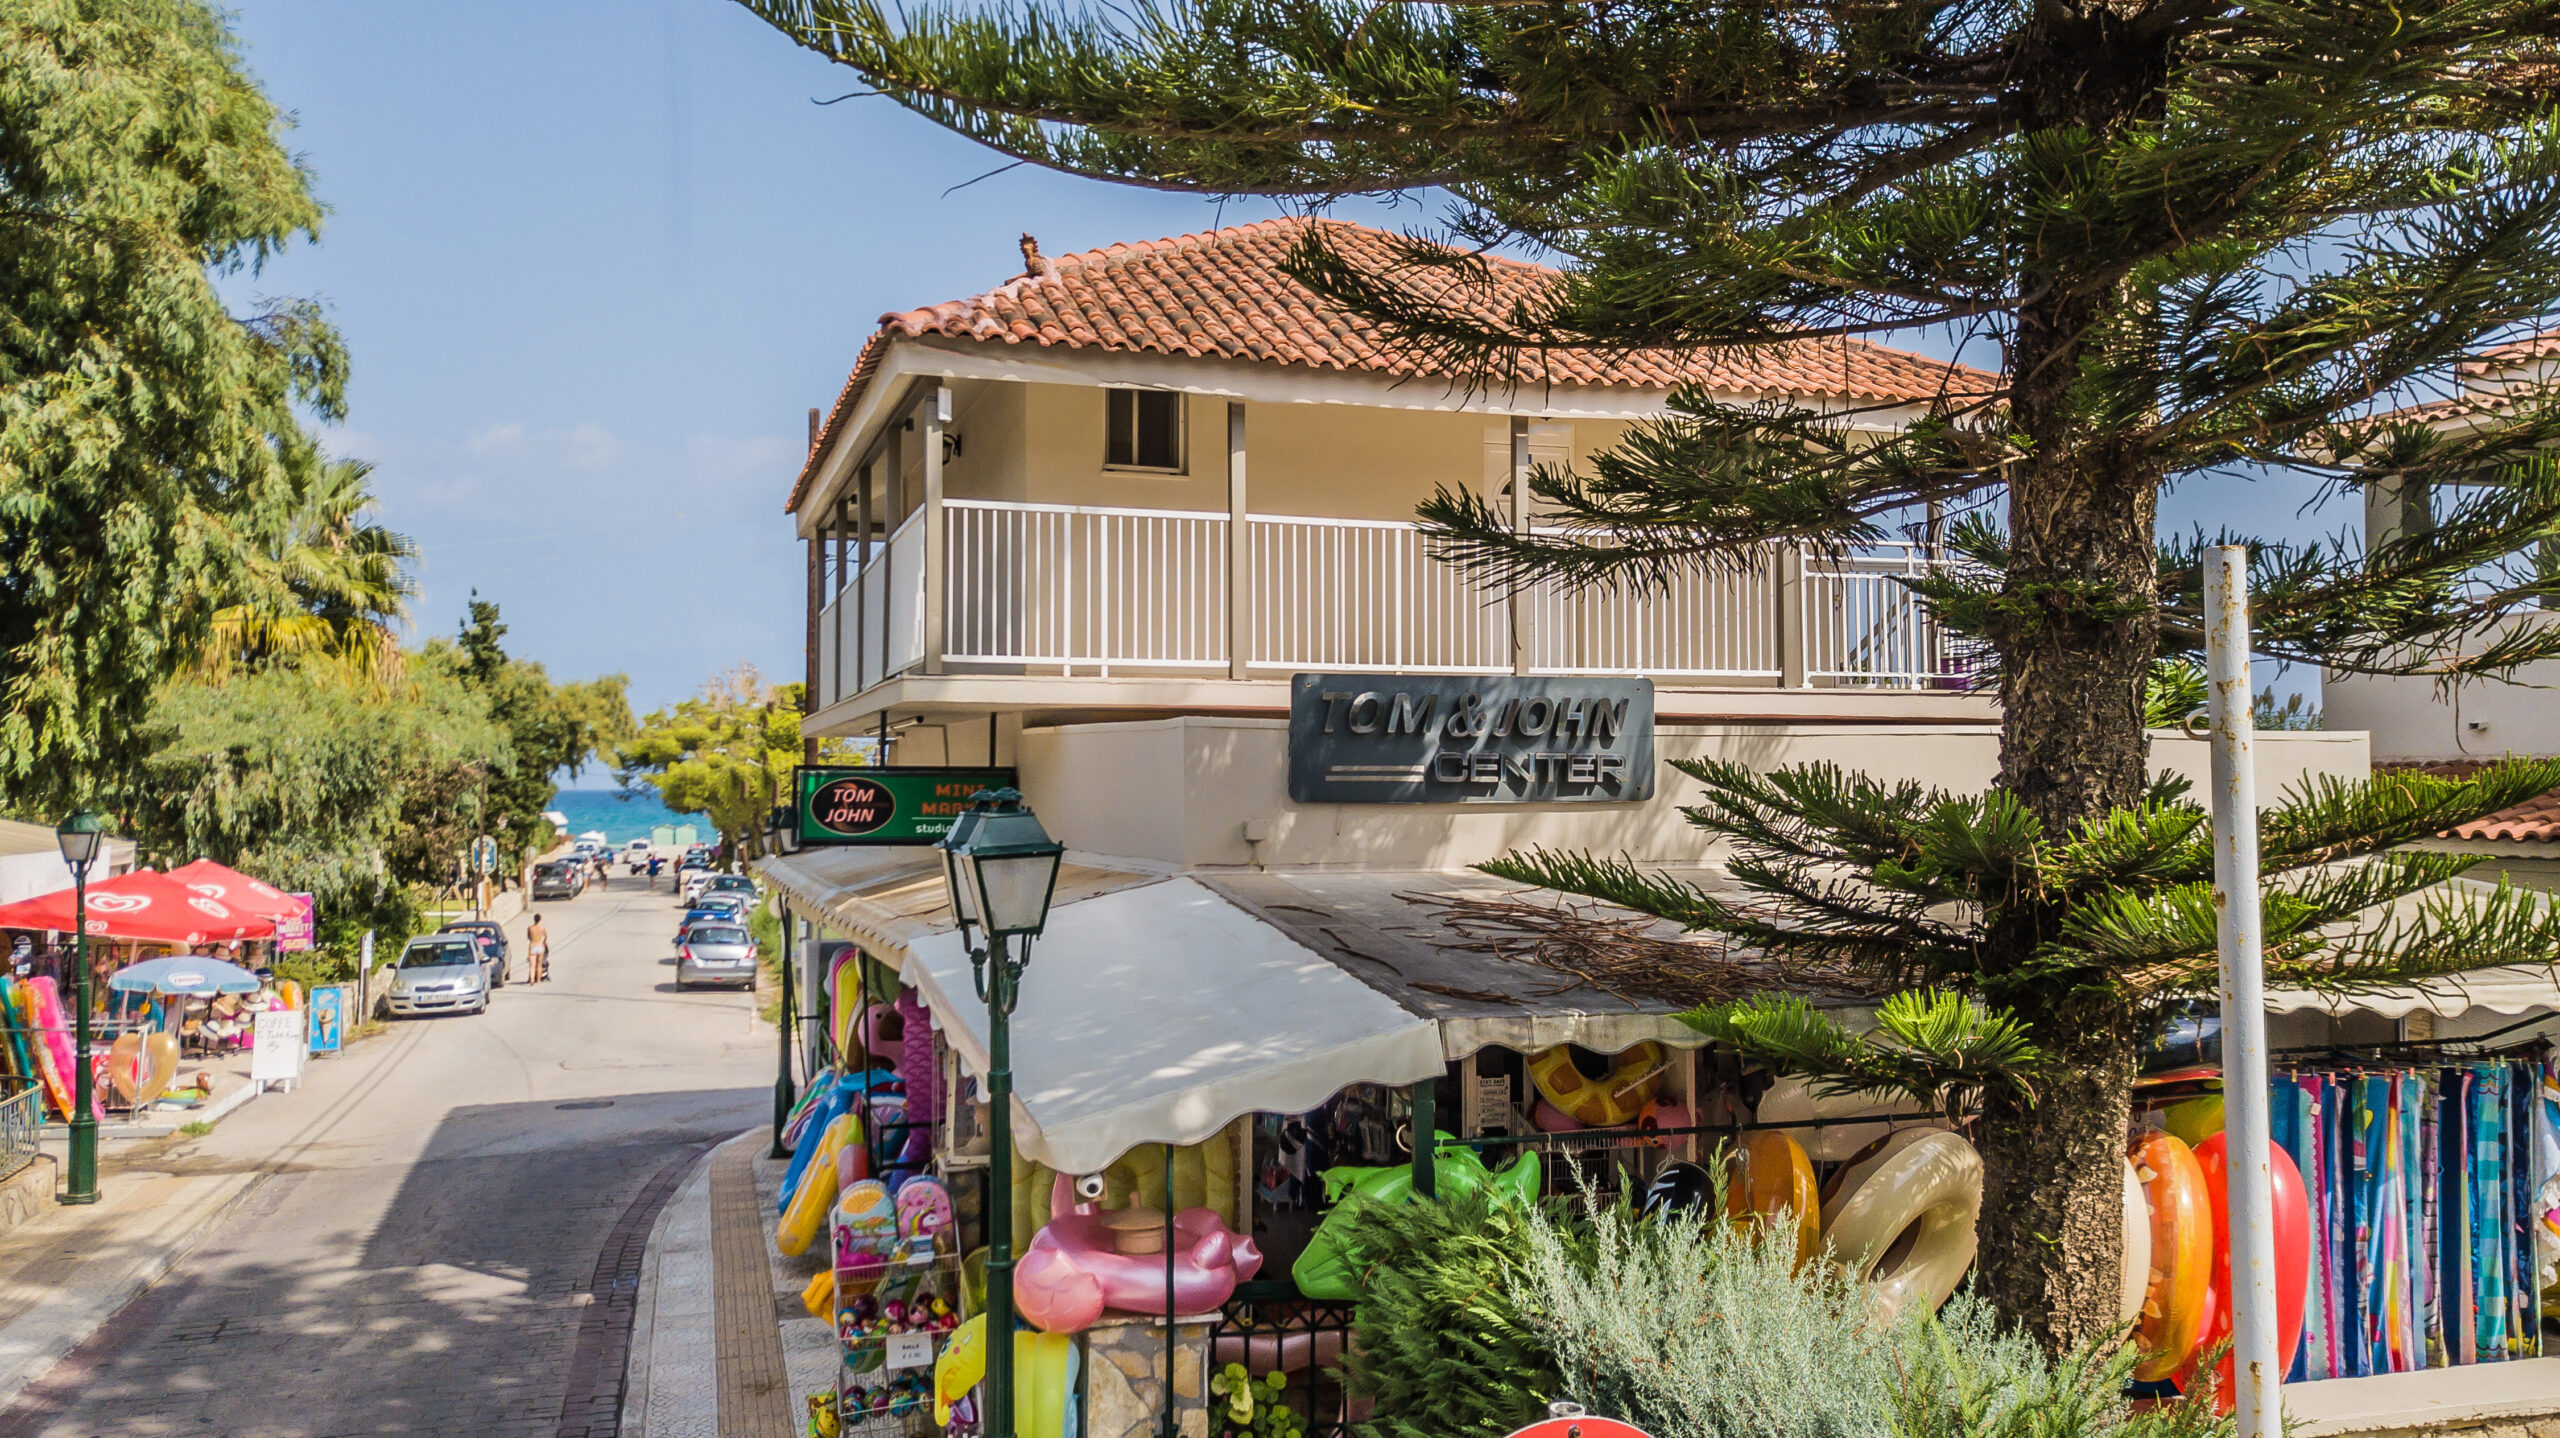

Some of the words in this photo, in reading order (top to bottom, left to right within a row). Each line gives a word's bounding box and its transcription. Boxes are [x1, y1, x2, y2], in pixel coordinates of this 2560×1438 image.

[1322, 691, 1439, 735] TOM
[1448, 690, 1488, 738] &
[1493, 696, 1630, 738] JOHN
[1434, 751, 1627, 784] CENTER
[833, 788, 875, 803] TOM
[824, 808, 875, 823] JOHN
